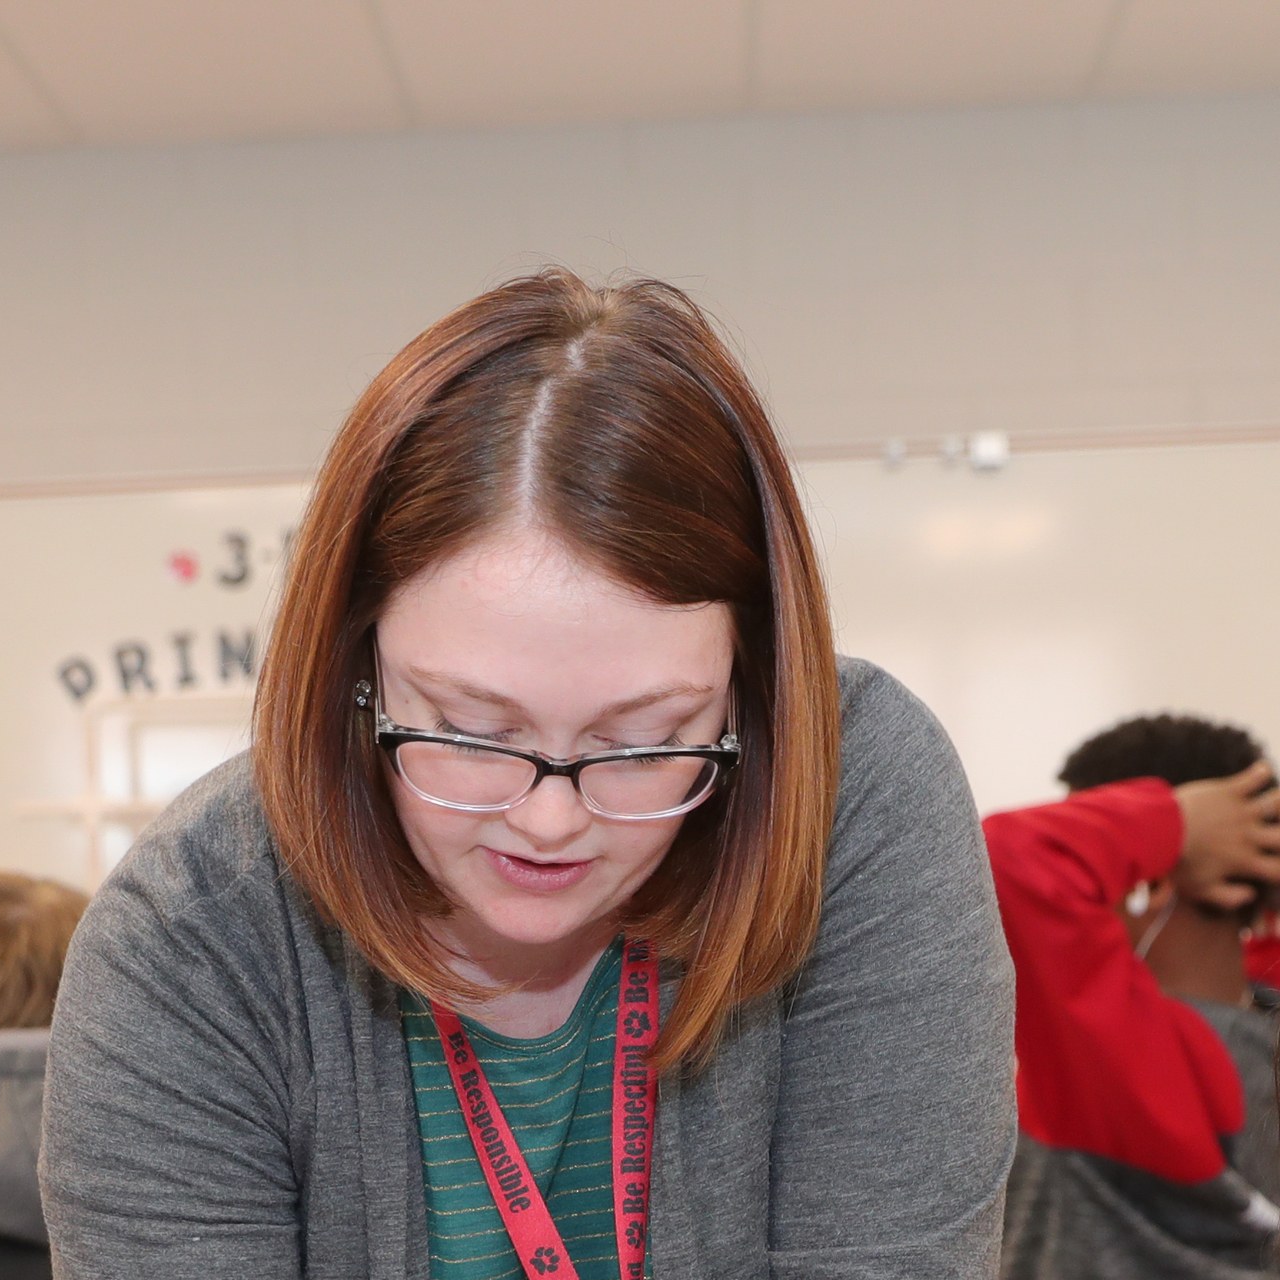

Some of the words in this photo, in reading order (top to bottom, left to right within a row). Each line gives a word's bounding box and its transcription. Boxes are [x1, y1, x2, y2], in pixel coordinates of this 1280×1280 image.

[448, 1031, 469, 1066] Be
[460, 1069, 532, 1214] Responsible
[622, 1181, 646, 1216] Be
